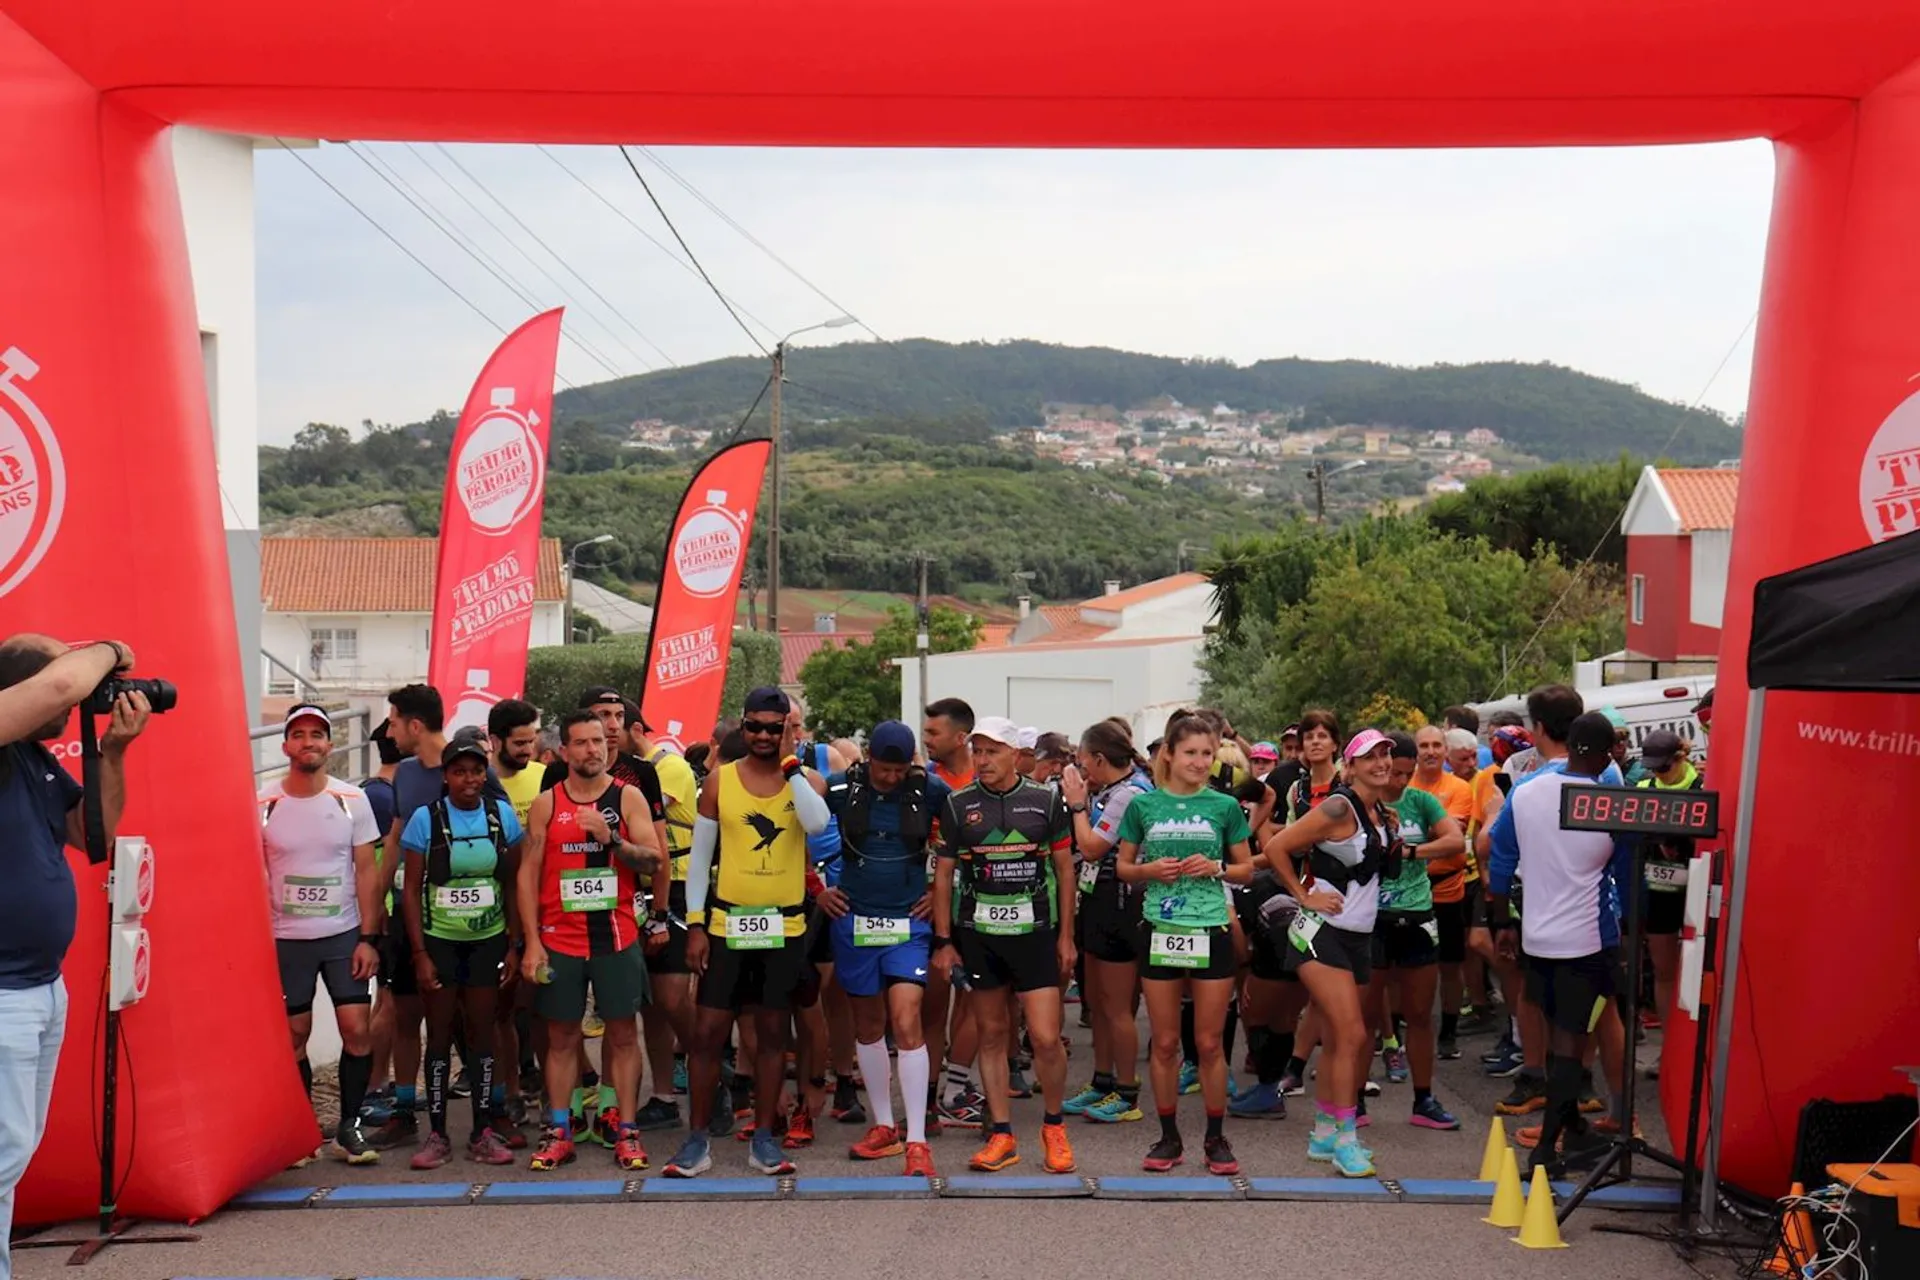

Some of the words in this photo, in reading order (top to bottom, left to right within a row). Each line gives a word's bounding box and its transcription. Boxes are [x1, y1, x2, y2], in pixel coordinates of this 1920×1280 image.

[1798, 721, 1920, 756] www.trilh
[1573, 795, 1707, 827] 09:27:19
[1653, 867, 1675, 880] 557
[297, 887, 328, 902] 552
[573, 880, 604, 895] 564
[450, 889, 480, 903] 555
[989, 906, 1019, 920] 625
[738, 917, 769, 932] 550
[866, 917, 895, 929] 545
[1166, 936, 1194, 951] 621
[430, 1060, 446, 1113] Kalenji
[480, 1056, 494, 1108] Kalenji
